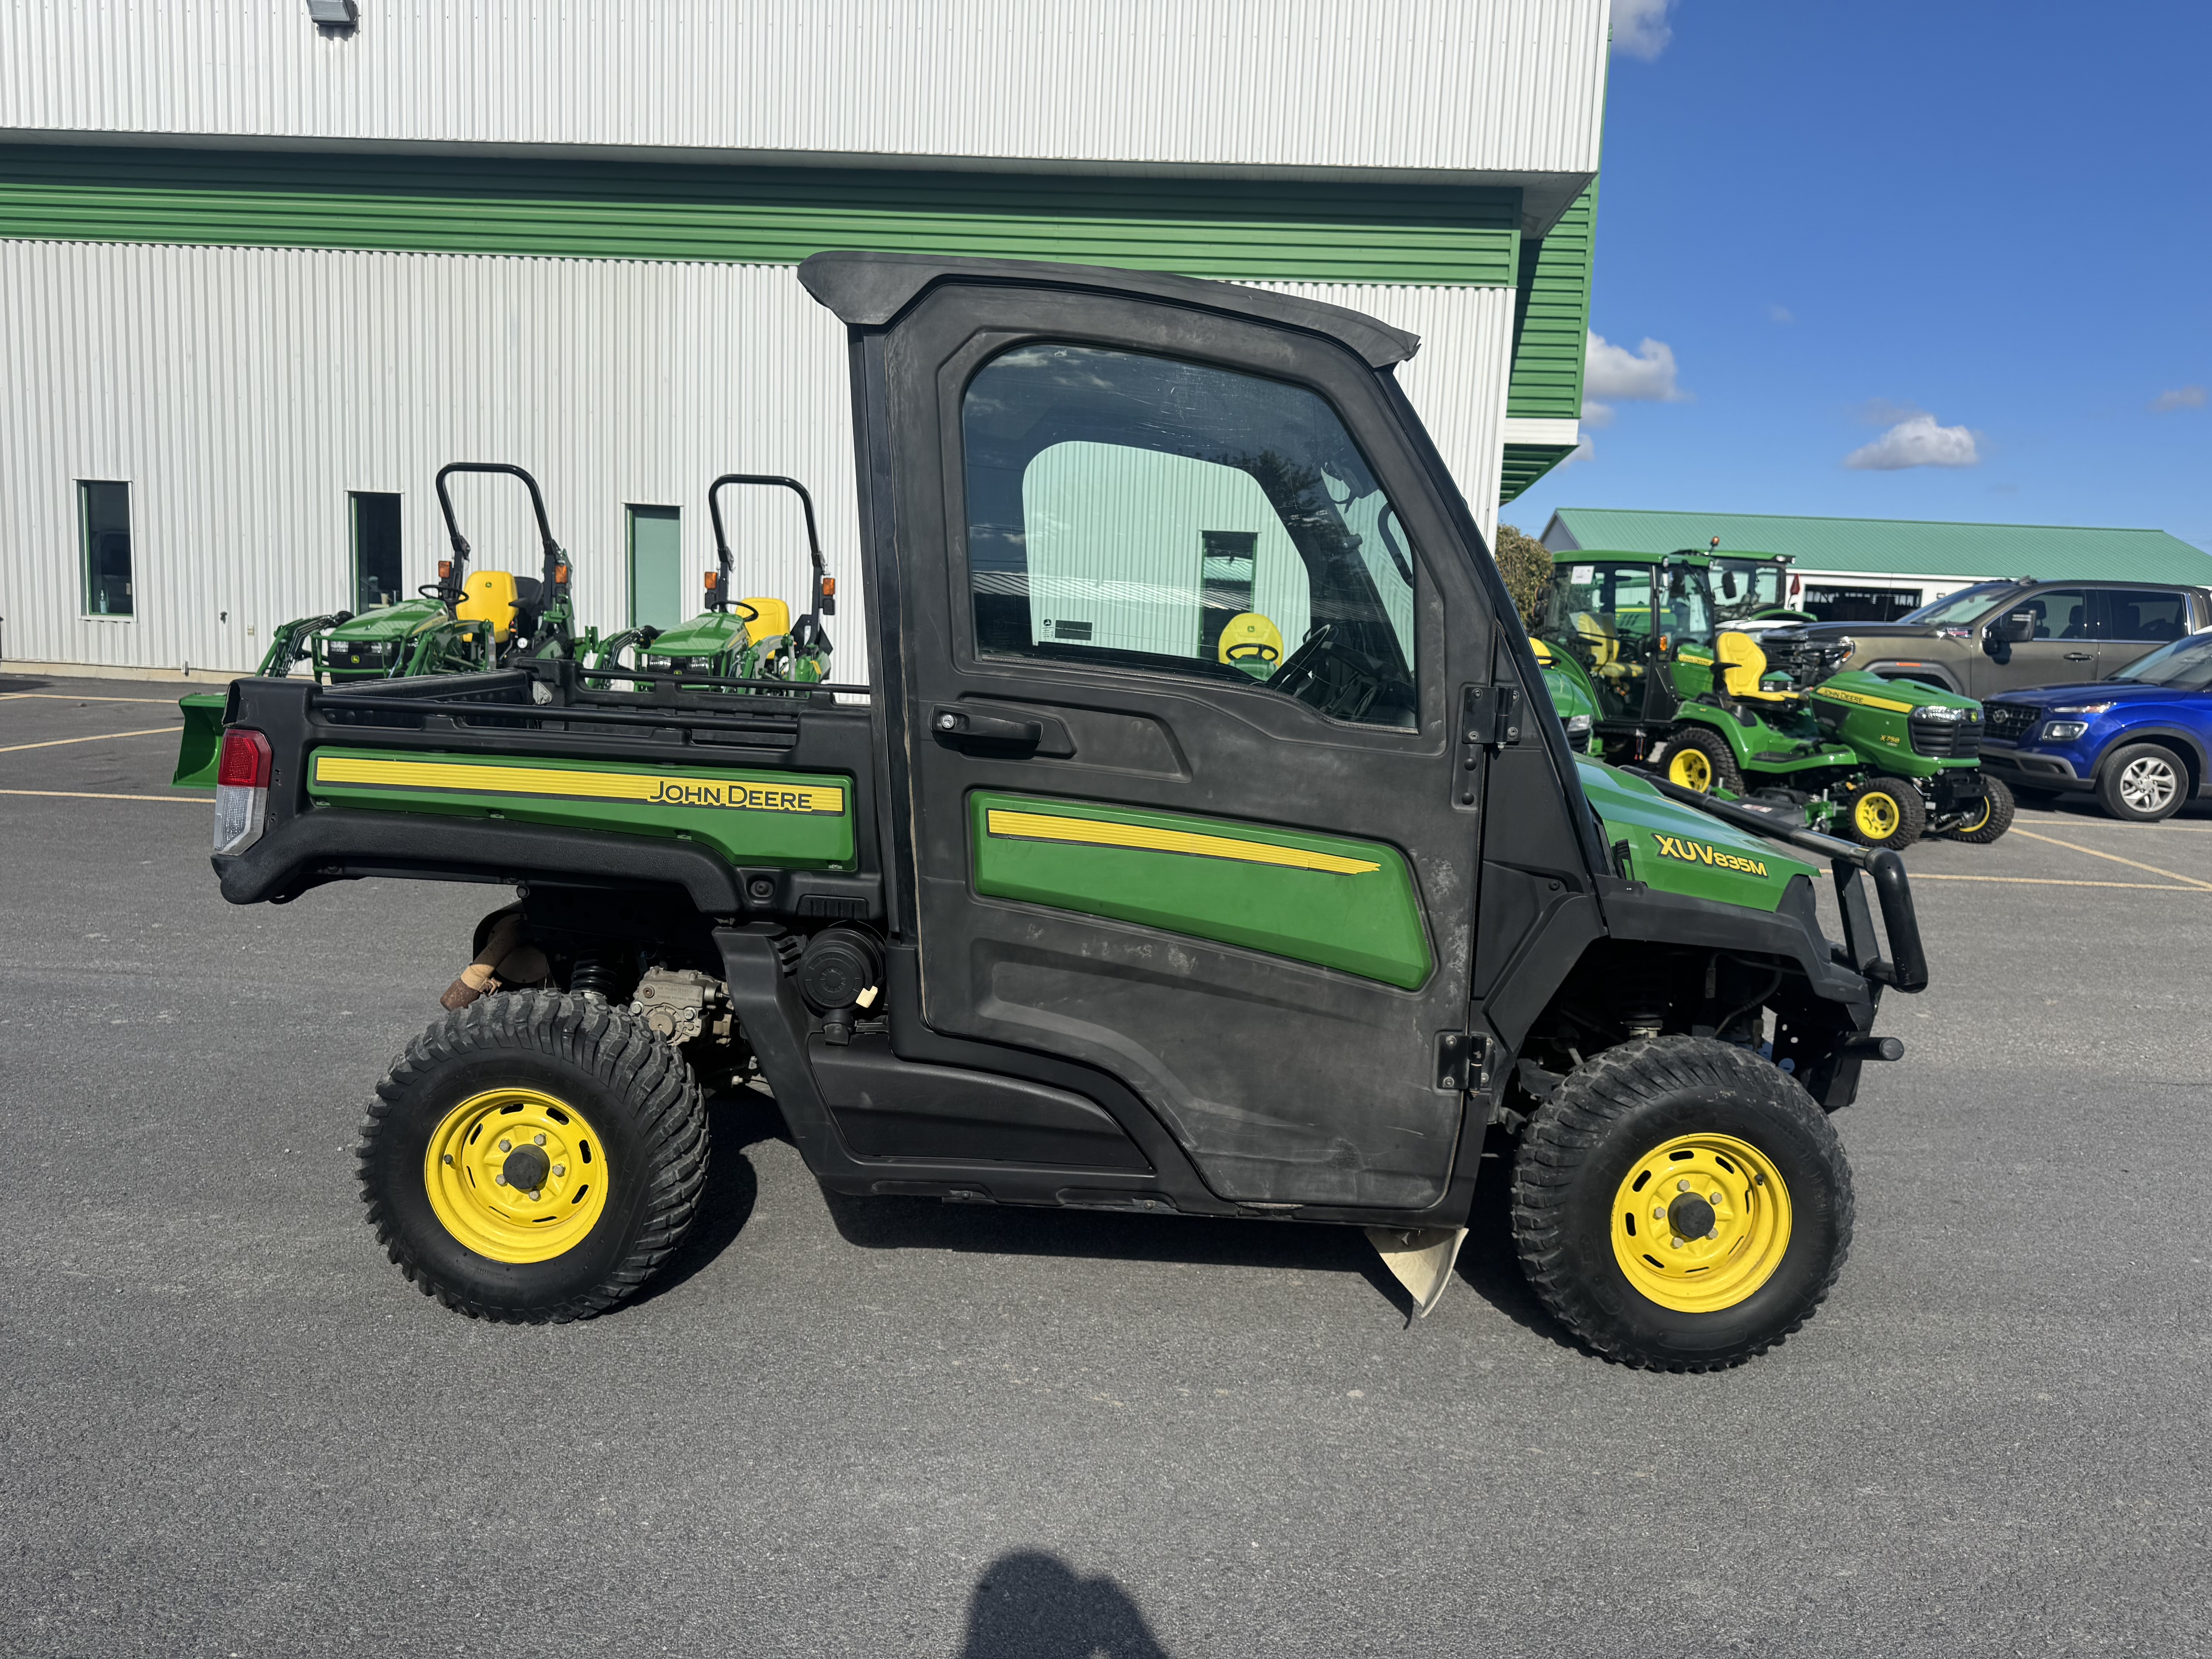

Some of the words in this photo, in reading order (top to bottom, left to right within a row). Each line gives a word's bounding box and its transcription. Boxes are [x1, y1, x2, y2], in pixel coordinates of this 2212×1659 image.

[650, 781, 720, 804] JOHN
[728, 785, 812, 809] DEERE
[1654, 834, 1767, 877] XUV835M
